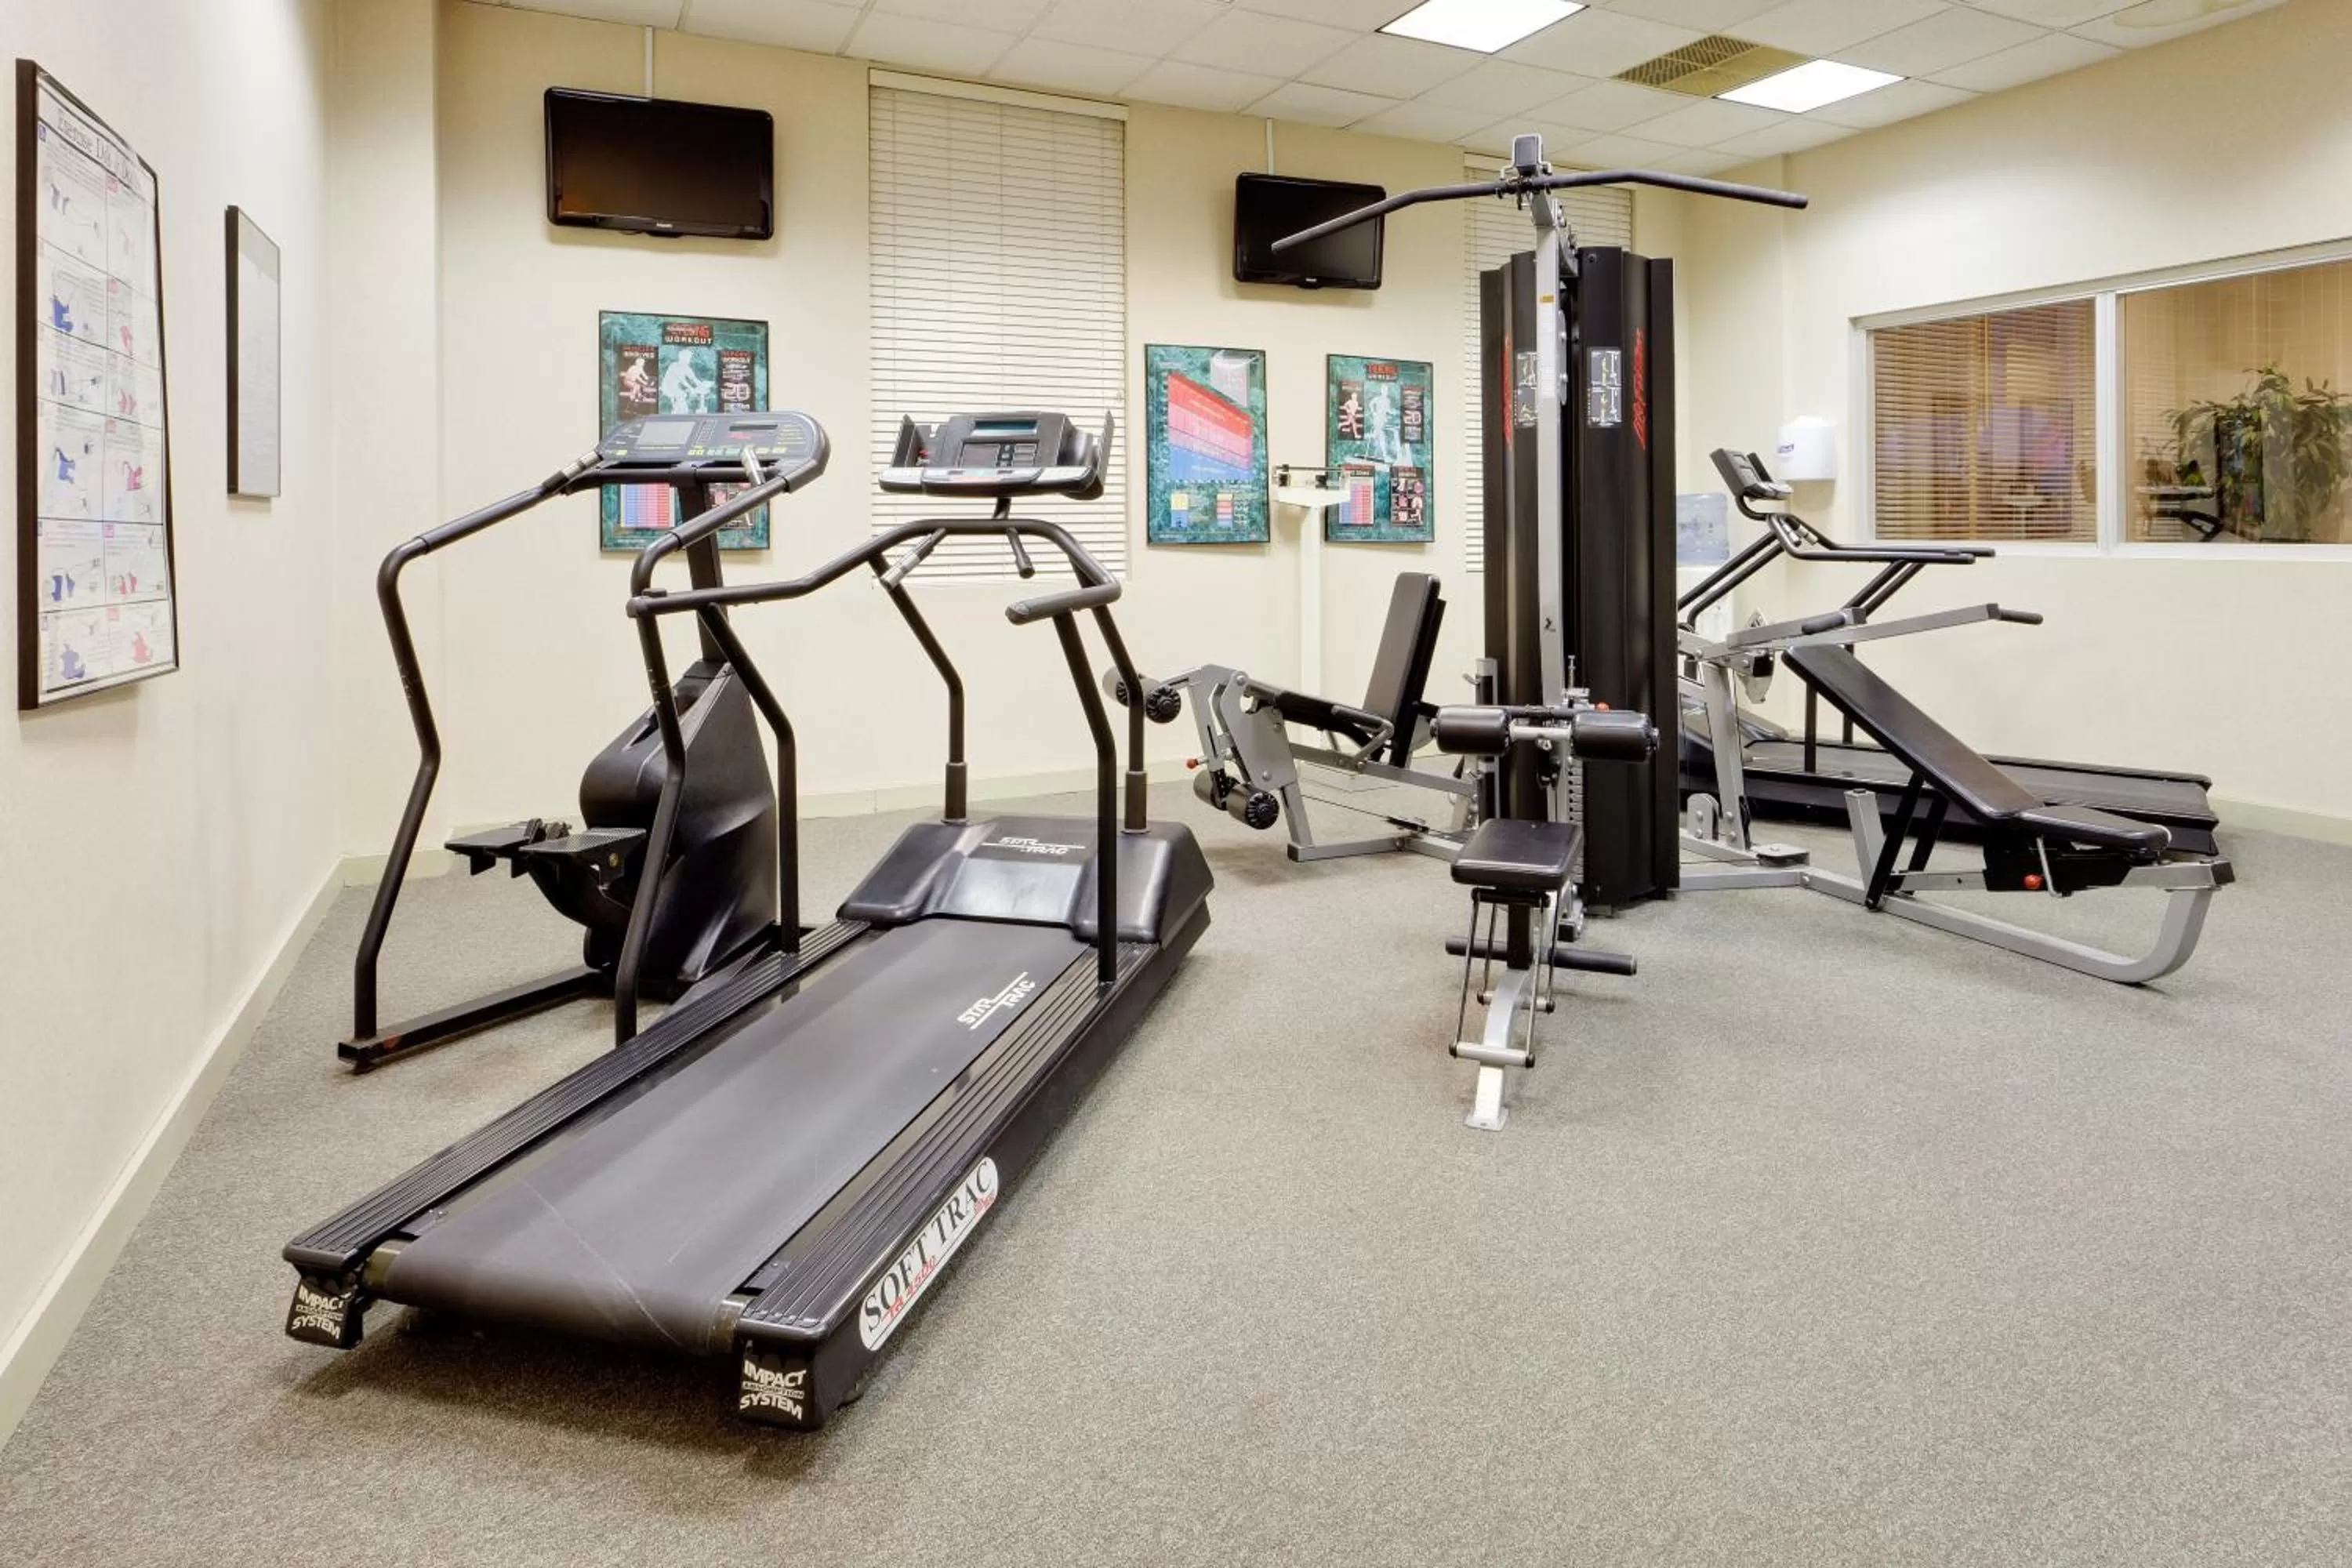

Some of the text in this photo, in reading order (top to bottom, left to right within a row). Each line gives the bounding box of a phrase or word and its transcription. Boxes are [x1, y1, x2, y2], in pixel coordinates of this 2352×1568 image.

[665, 336, 713, 344] WORKOUT
[1000, 980, 1036, 1008] TRAC
[957, 997, 991, 1025] STAR
[864, 1232, 928, 1332] SOFT
[931, 1162, 992, 1245] TRAC
[299, 1284, 348, 1310] IMPACT
[291, 1316, 341, 1339] SYSTEM
[744, 1359, 807, 1388] IMPACT
[739, 1392, 803, 1421] SYSTEM
